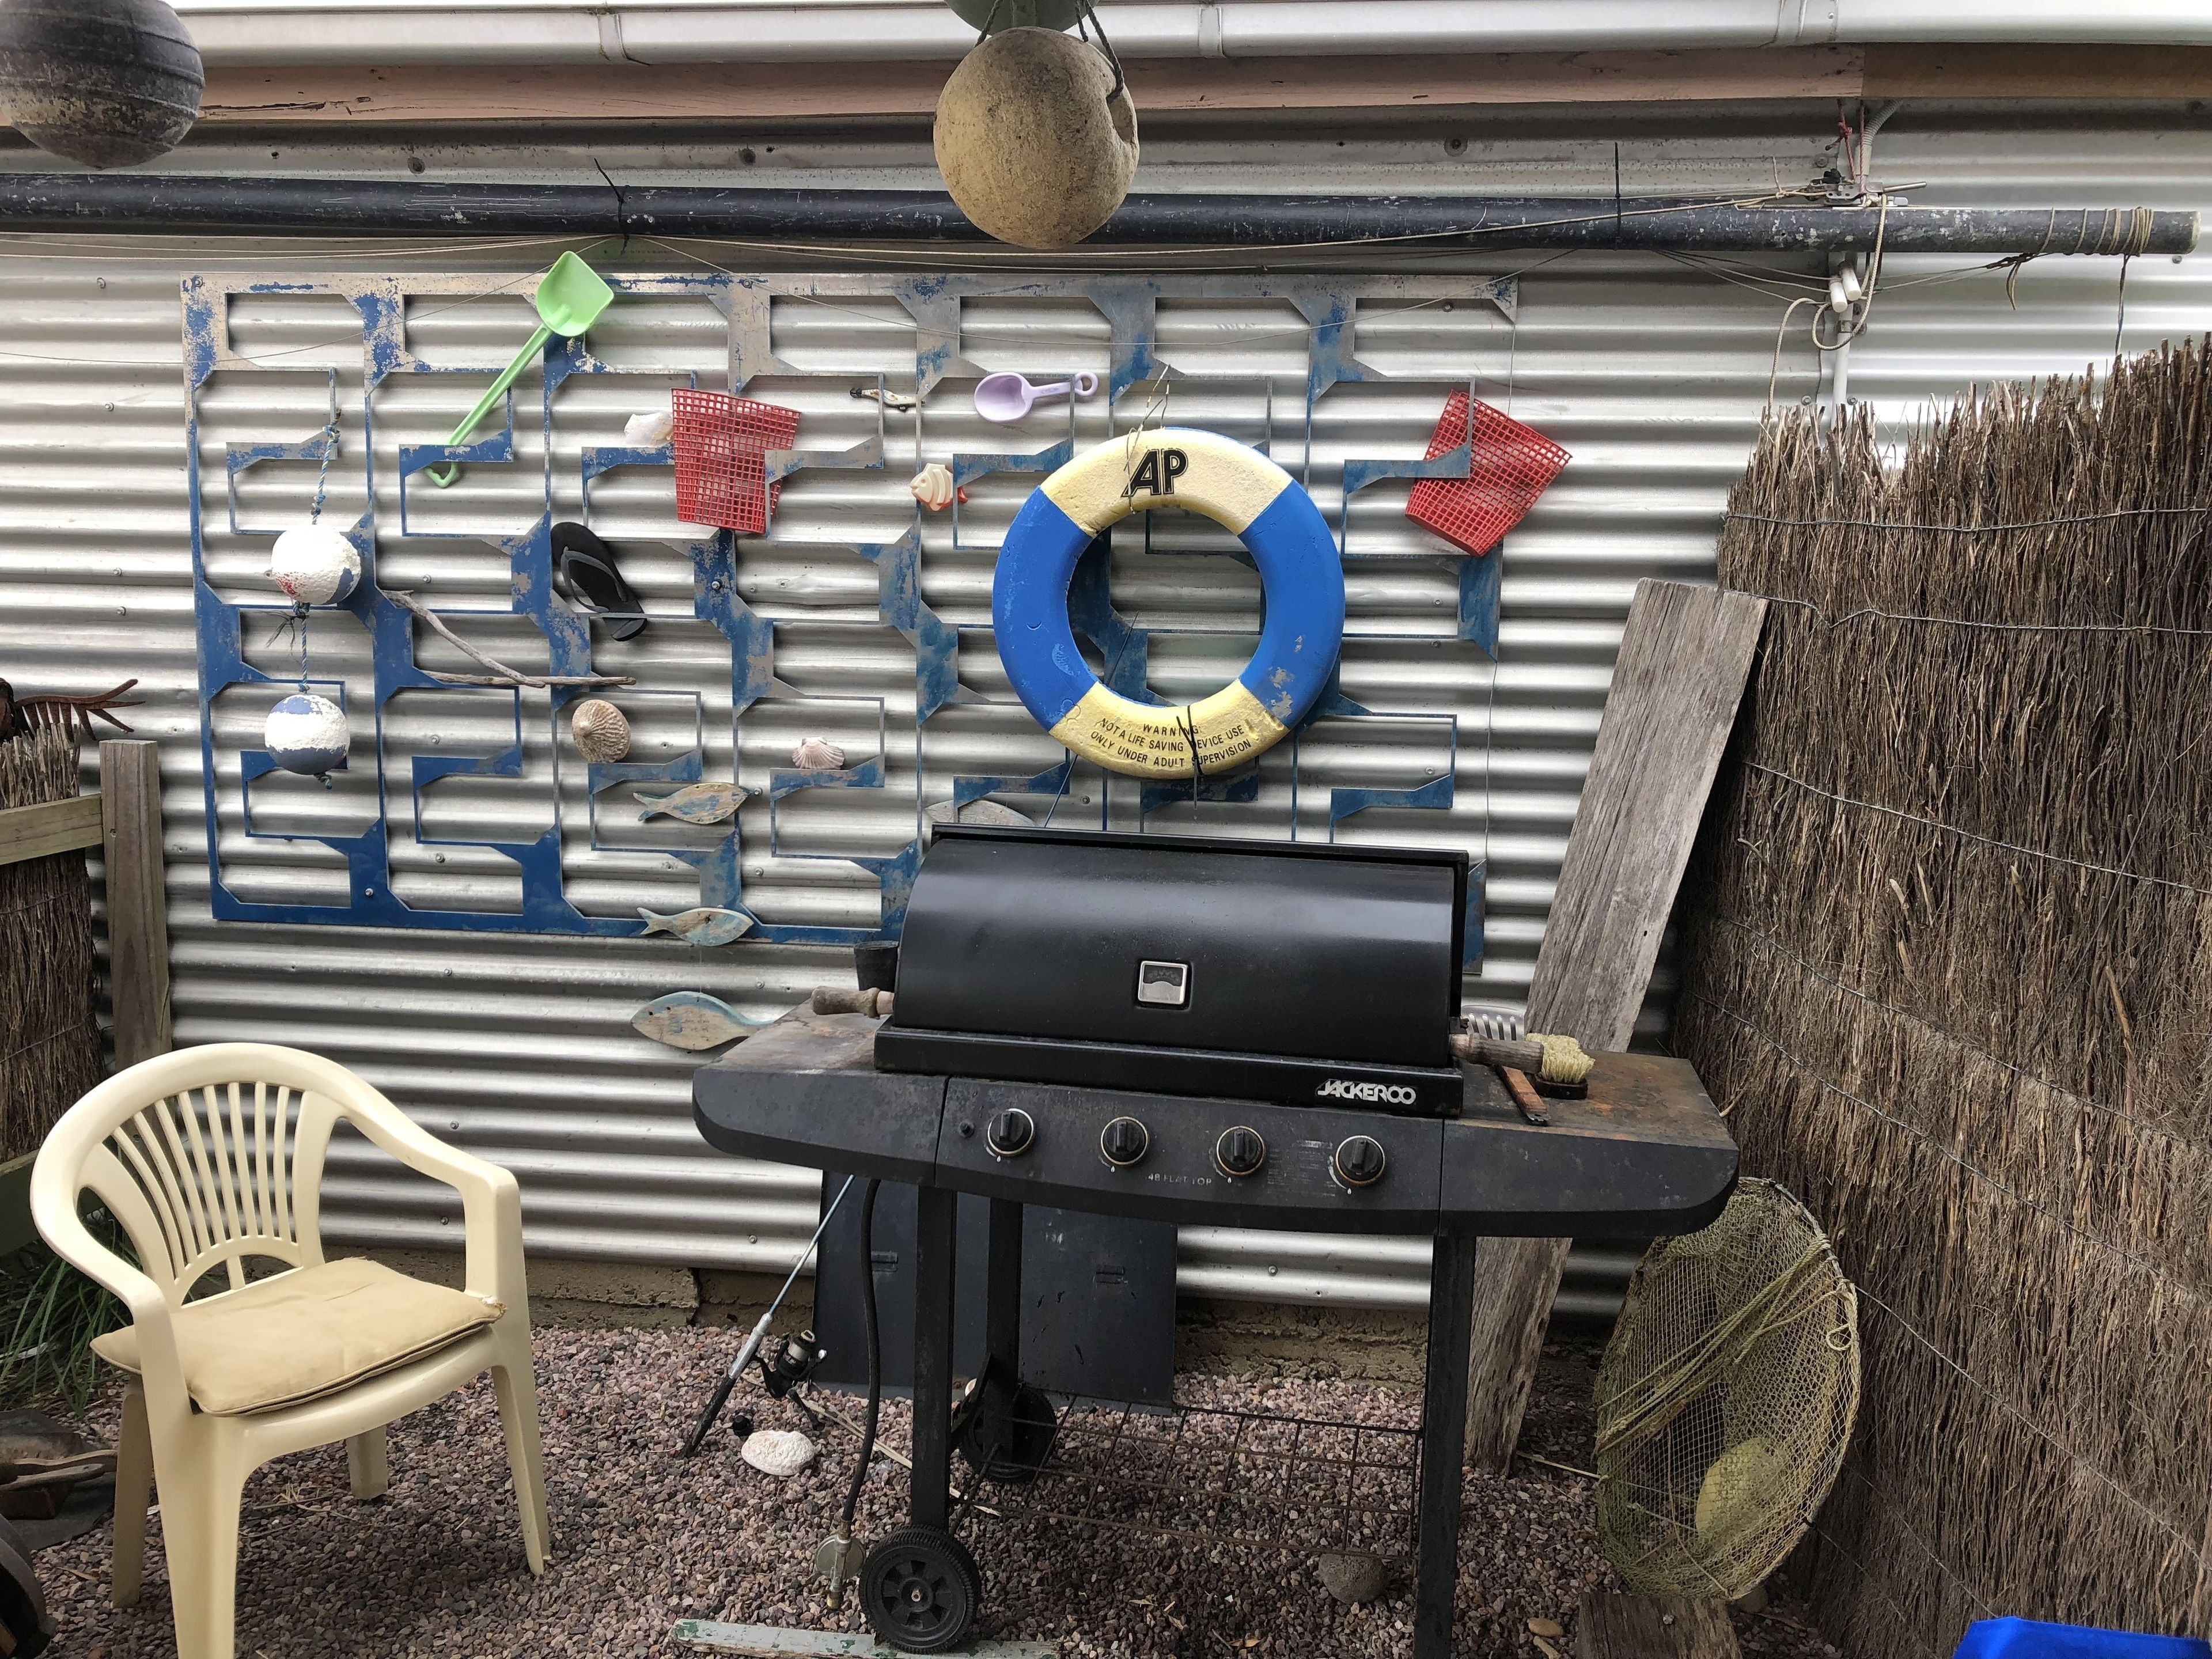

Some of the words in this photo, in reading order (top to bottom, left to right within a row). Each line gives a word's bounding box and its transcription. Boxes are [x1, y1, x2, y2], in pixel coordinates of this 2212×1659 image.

[1120, 448, 1188, 498] AP
[1091, 731, 1115, 749] ONLY
[1118, 745, 1148, 764] UNDER
[1101, 718, 1120, 734] NOT
[1119, 730, 1126, 739] A
[1128, 733, 1146, 747] LIFE
[1149, 740, 1184, 752] SAVING
[1191, 734, 1224, 749] EVICE
[1225, 725, 1244, 740] USE
[1317, 1080, 1416, 1104] JACKEROO
